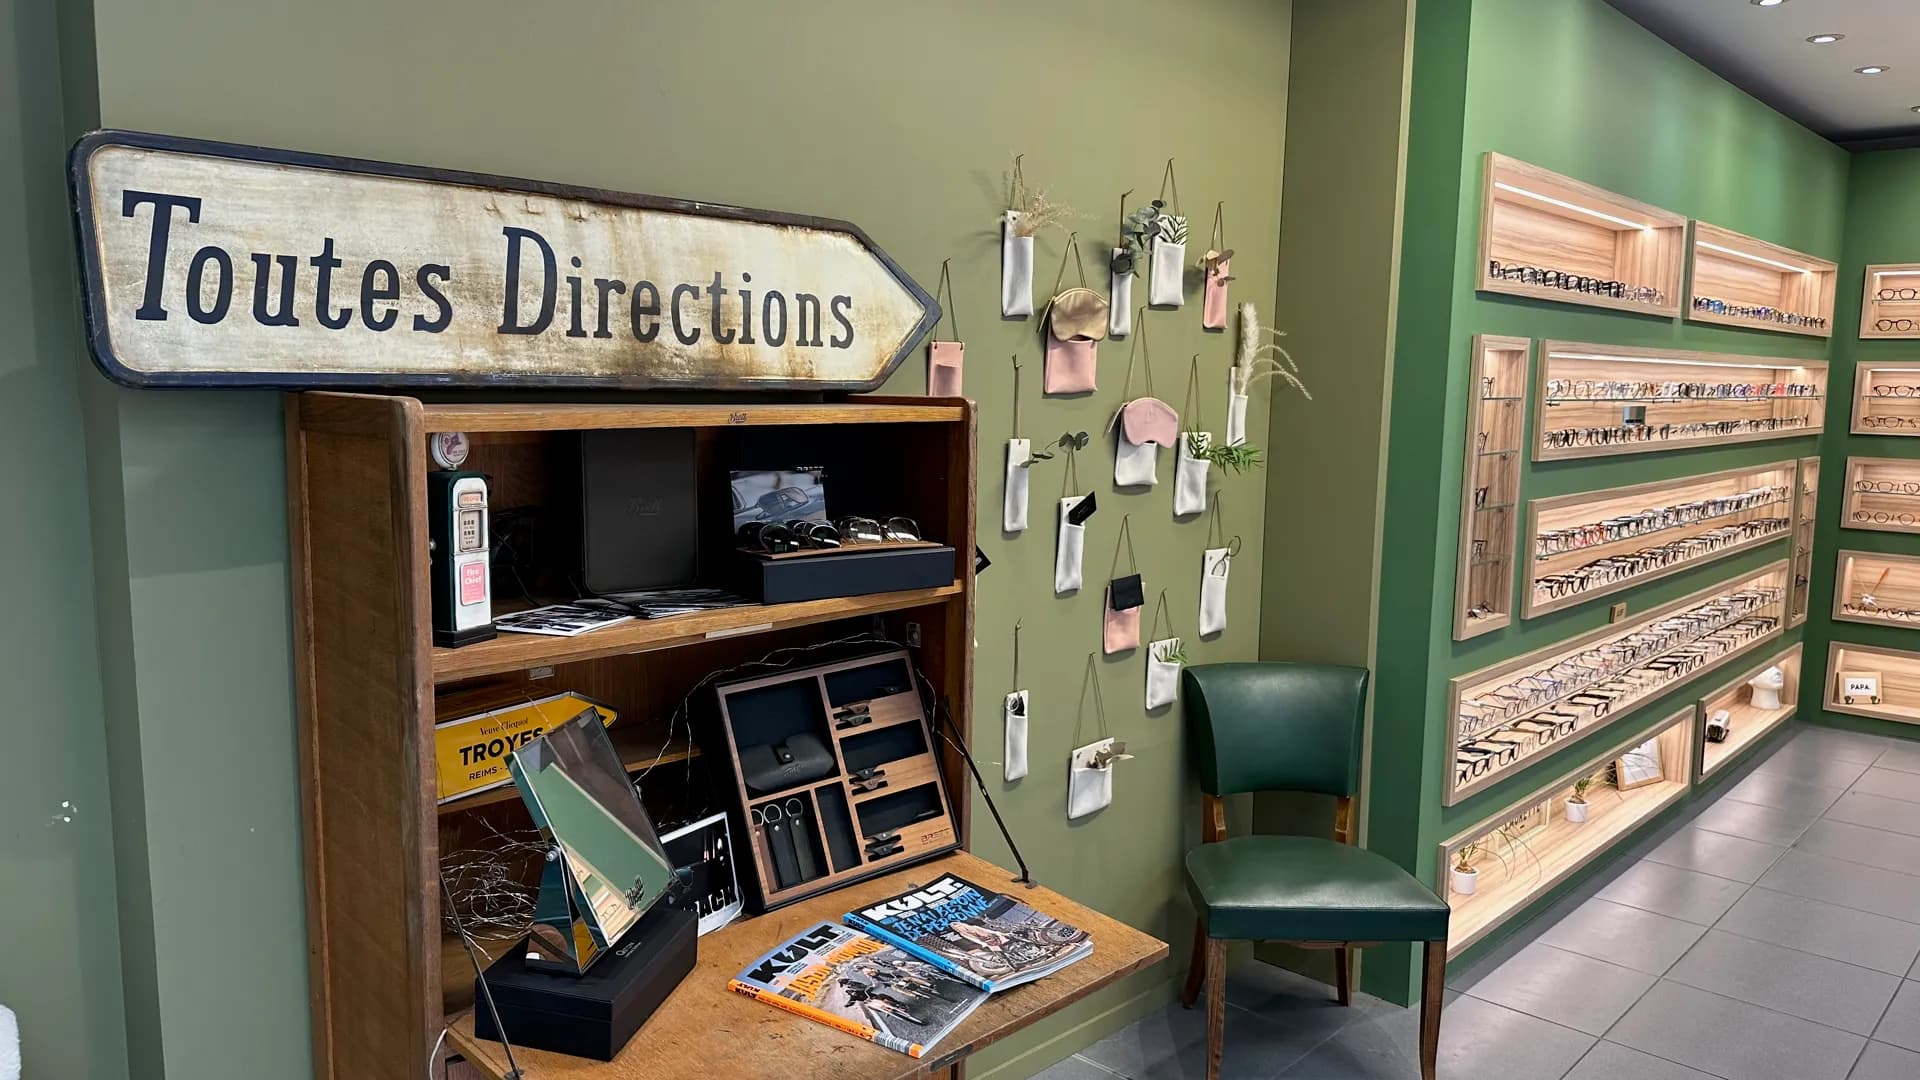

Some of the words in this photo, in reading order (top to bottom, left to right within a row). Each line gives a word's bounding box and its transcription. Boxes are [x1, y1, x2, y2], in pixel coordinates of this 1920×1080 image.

[122, 190, 453, 334] Toutes
[497, 226, 855, 350] Directions
[469, 766, 498, 781] REIMS
[747, 925, 841, 984] KULT
